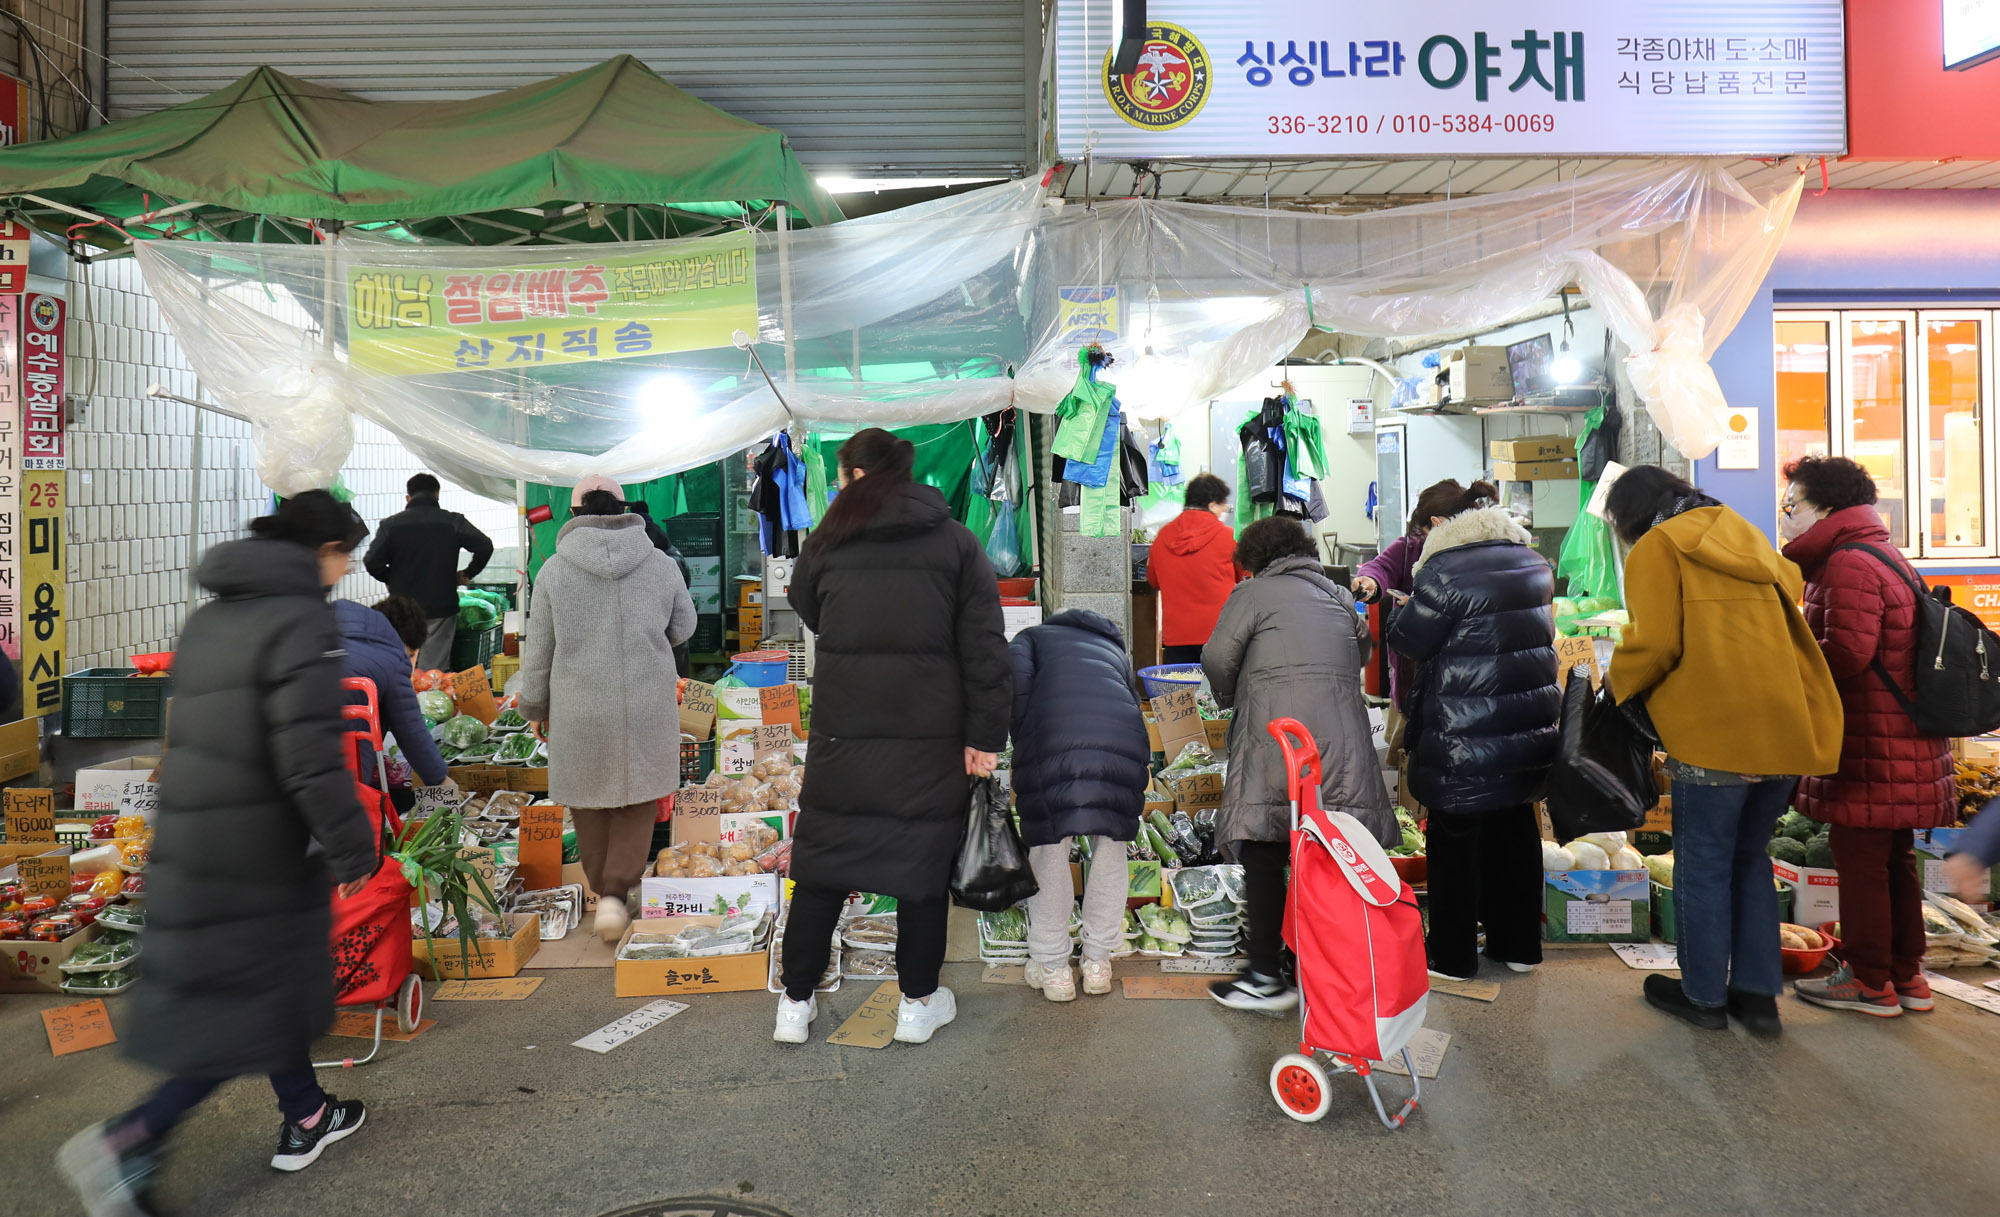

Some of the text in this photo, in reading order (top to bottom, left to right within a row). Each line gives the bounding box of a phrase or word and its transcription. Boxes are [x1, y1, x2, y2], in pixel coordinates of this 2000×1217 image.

[1616, 37, 1715, 61] 각종야채
[1237, 30, 1584, 101] 싱싱나라 야채
[1133, 110, 1178, 122] MARINE
[1179, 83, 1204, 114] CORPS
[1267, 115, 1368, 134] 336-3210
[1393, 114, 1555, 134] 010-5384-0069
[353, 248, 748, 329] 해남 절임배추 주문예약 받습니다
[1068, 312, 1110, 327] NSOK
[26, 331, 60, 456] 예수중심교회
[25, 458, 64, 469] 마포성전
[29, 482, 60, 508] 2층
[28, 517, 60, 709] 미용실
[1560, 639, 1591, 657] 섬초
[735, 698, 761, 706] 샤인머
[762, 725, 790, 738] 감자
[1185, 776, 1214, 792] 가지
[11, 794, 51, 813] 도라지
[424, 787, 454, 802] 새송이
[664, 901, 703, 917] 콜라비
[664, 966, 720, 986] 솔마을
